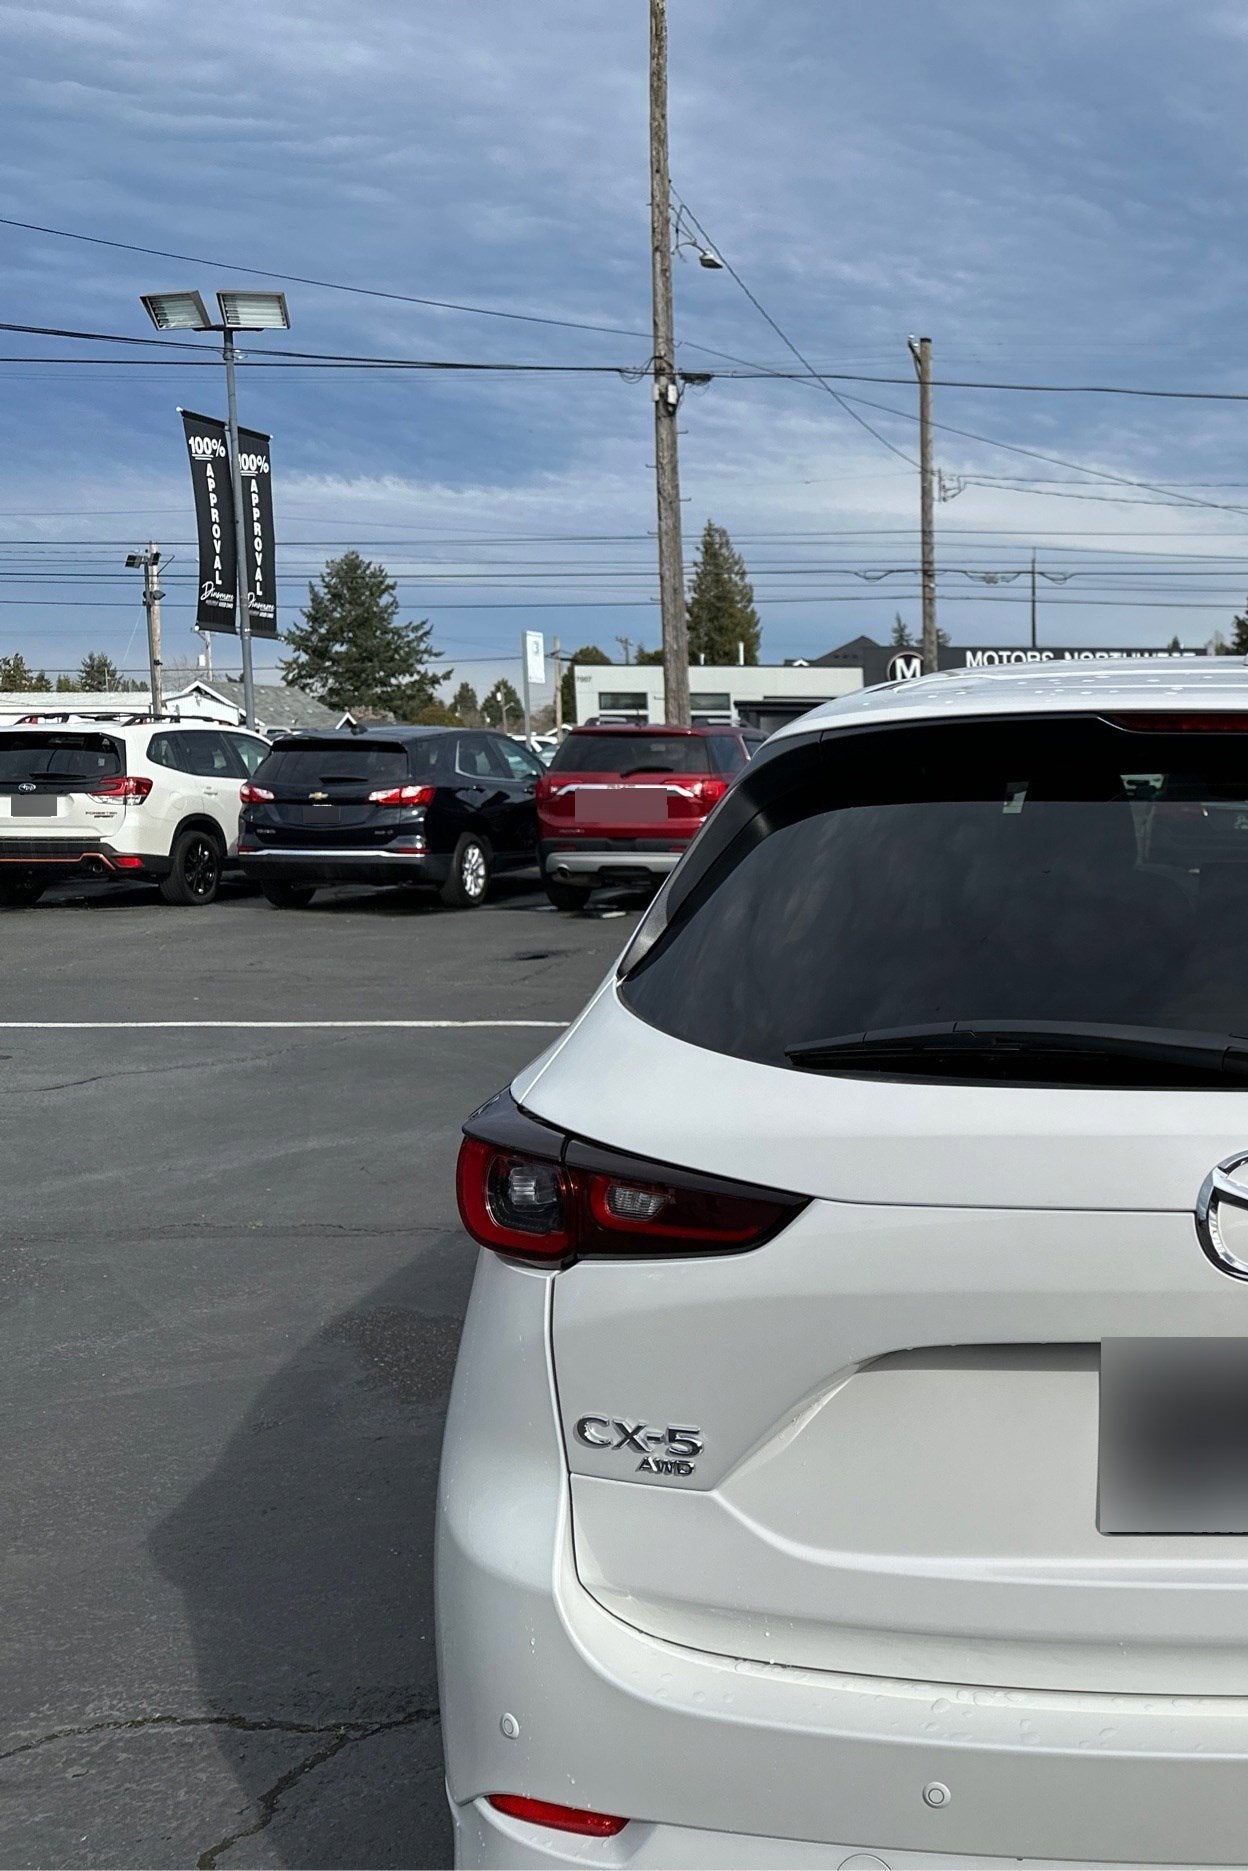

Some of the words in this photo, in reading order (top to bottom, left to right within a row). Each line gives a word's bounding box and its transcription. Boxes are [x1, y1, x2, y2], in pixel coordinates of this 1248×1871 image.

[188, 436, 226, 457] 100%
[206, 463, 222, 585] APPROVAL
[250, 479, 263, 596] APPROVAL
[895, 657, 921, 681] M
[966, 651, 1054, 668] MOTORS
[574, 1414, 703, 1457] CX-5
[637, 1456, 696, 1476] AWD
